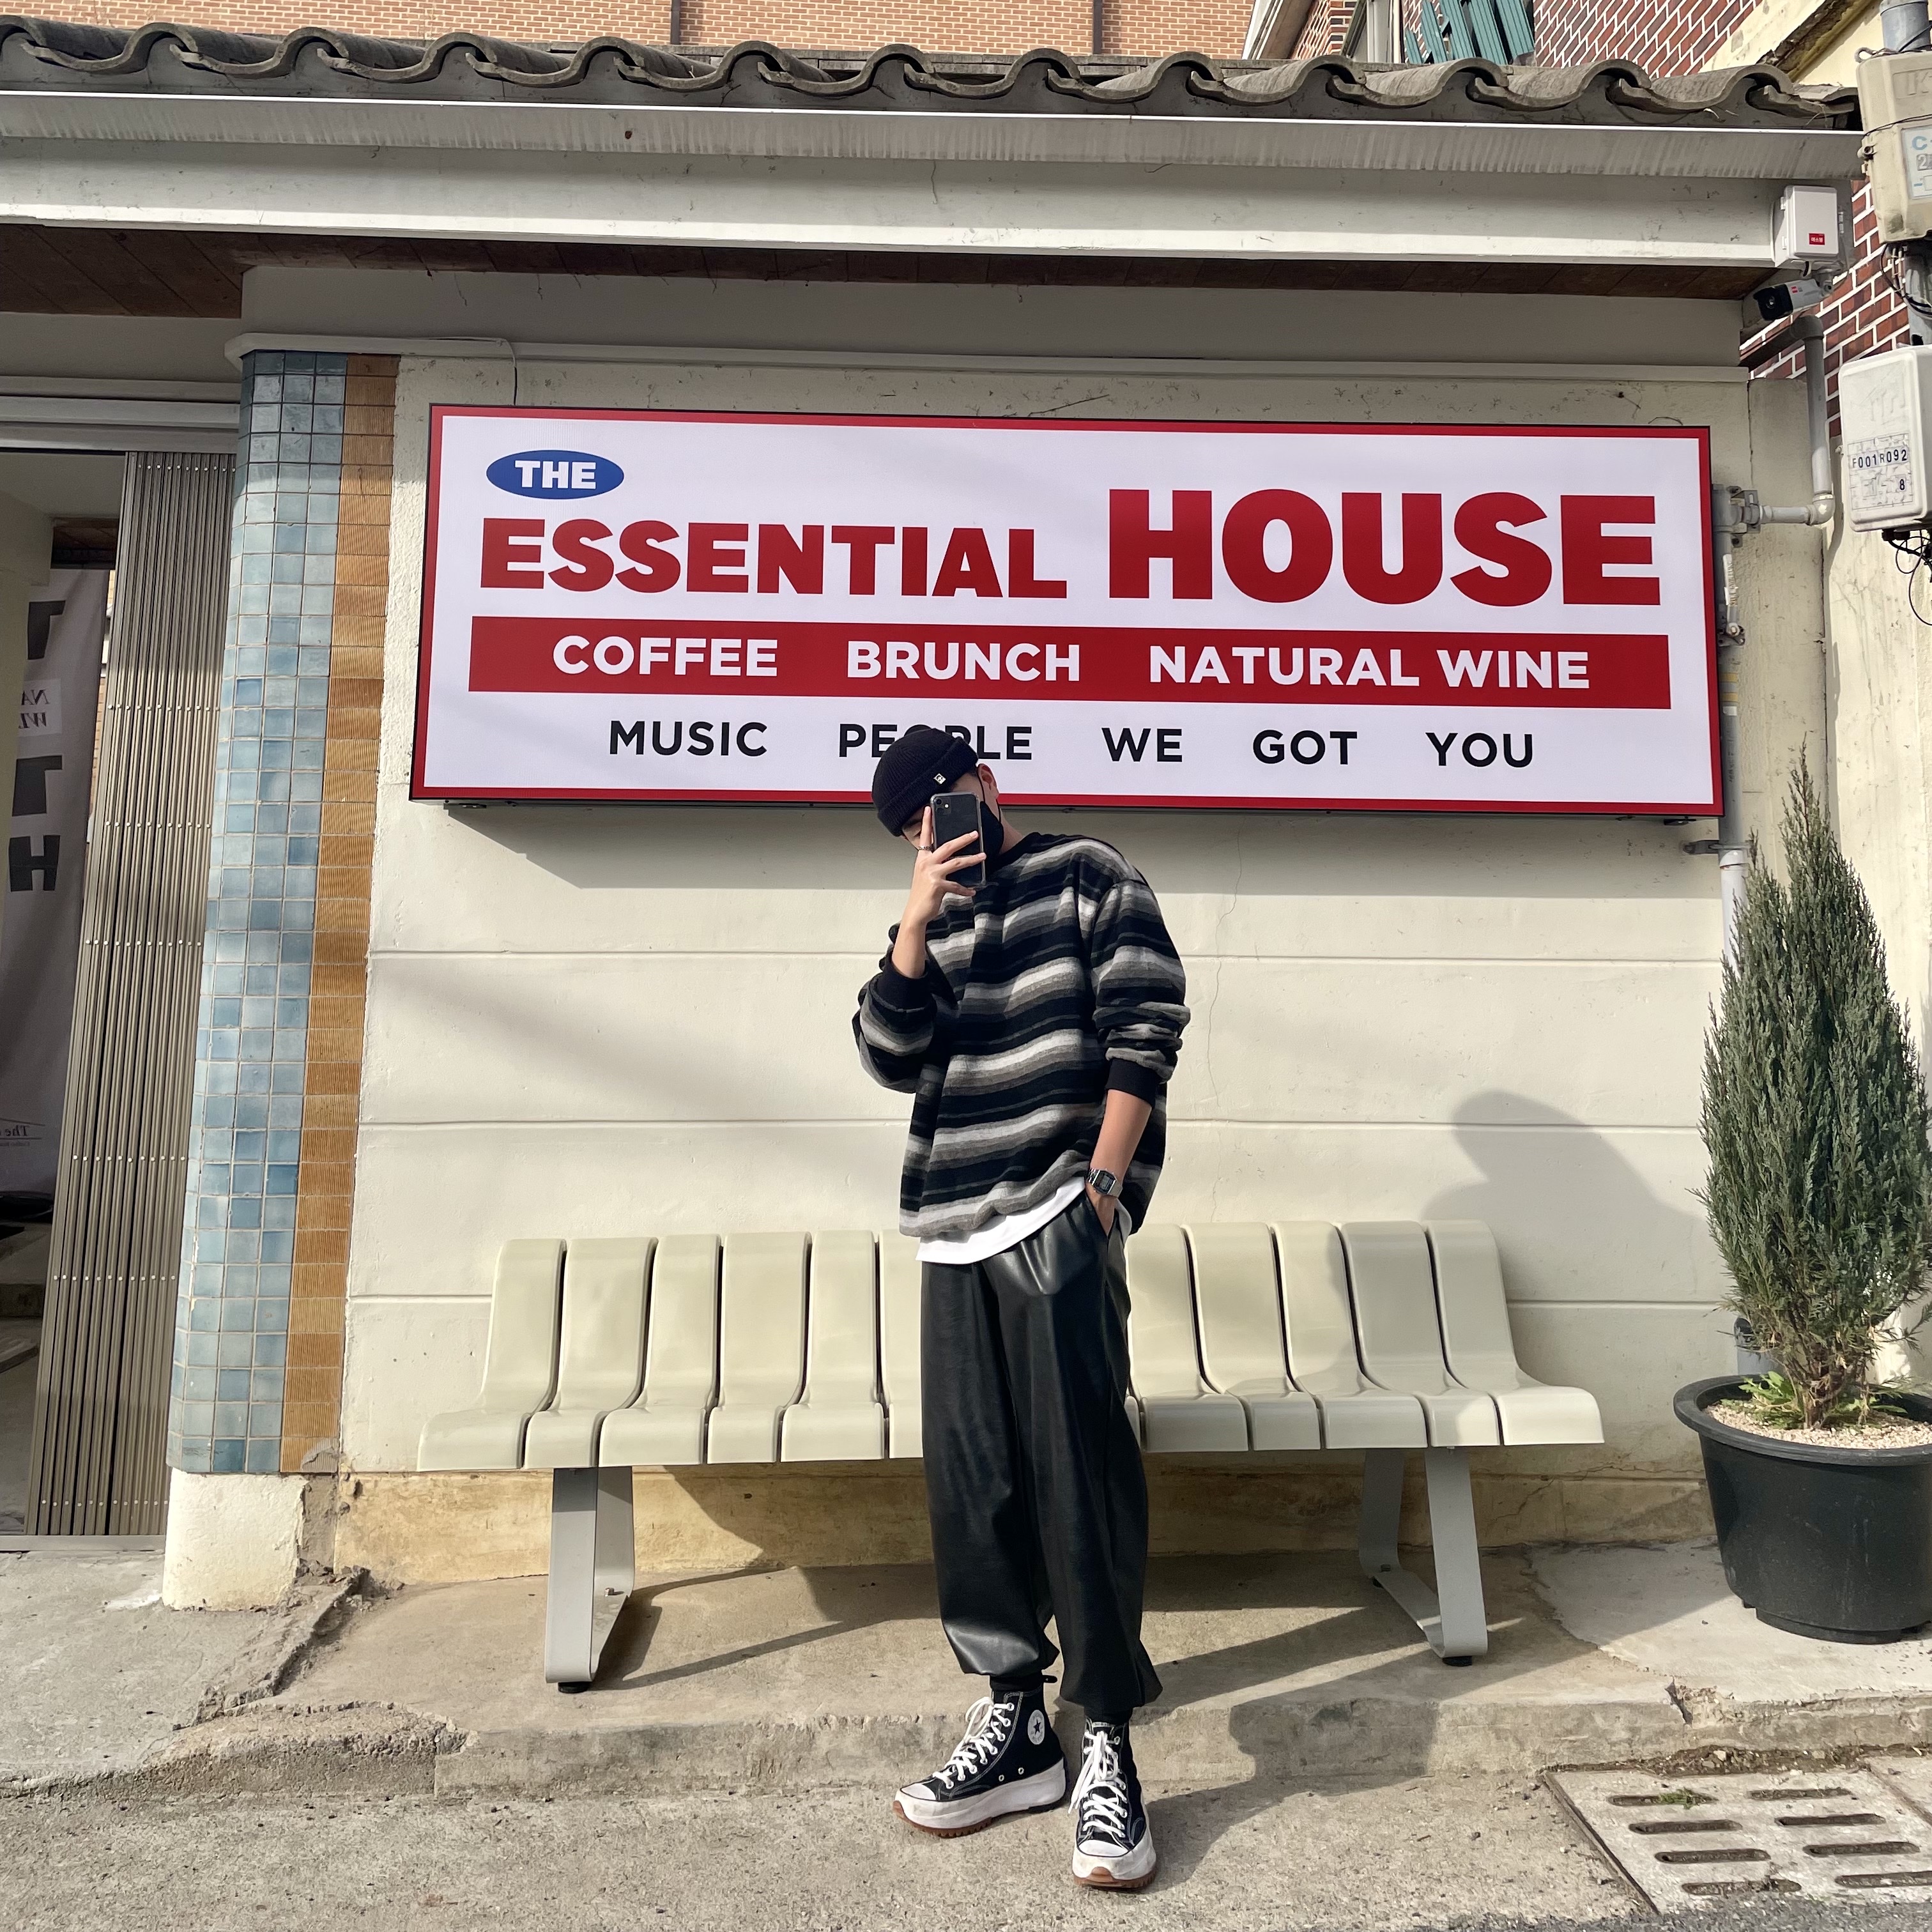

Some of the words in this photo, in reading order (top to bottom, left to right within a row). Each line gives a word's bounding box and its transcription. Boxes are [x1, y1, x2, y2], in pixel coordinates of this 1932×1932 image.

[514, 460, 596, 490] THE
[480, 518, 1067, 599] ESSENTIAL
[1108, 489, 1660, 607] HOUSE
[553, 635, 778, 677] COFFEE
[847, 641, 1080, 681] BRUNCH
[1150, 645, 1420, 686] NATURAL
[1437, 650, 1589, 689] WINE
[610, 720, 767, 757] MUSIC
[839, 723, 1032, 760] PELE
[1101, 727, 1183, 762] WE
[1253, 730, 1358, 765] GOT
[1426, 732, 1533, 768] YOU
